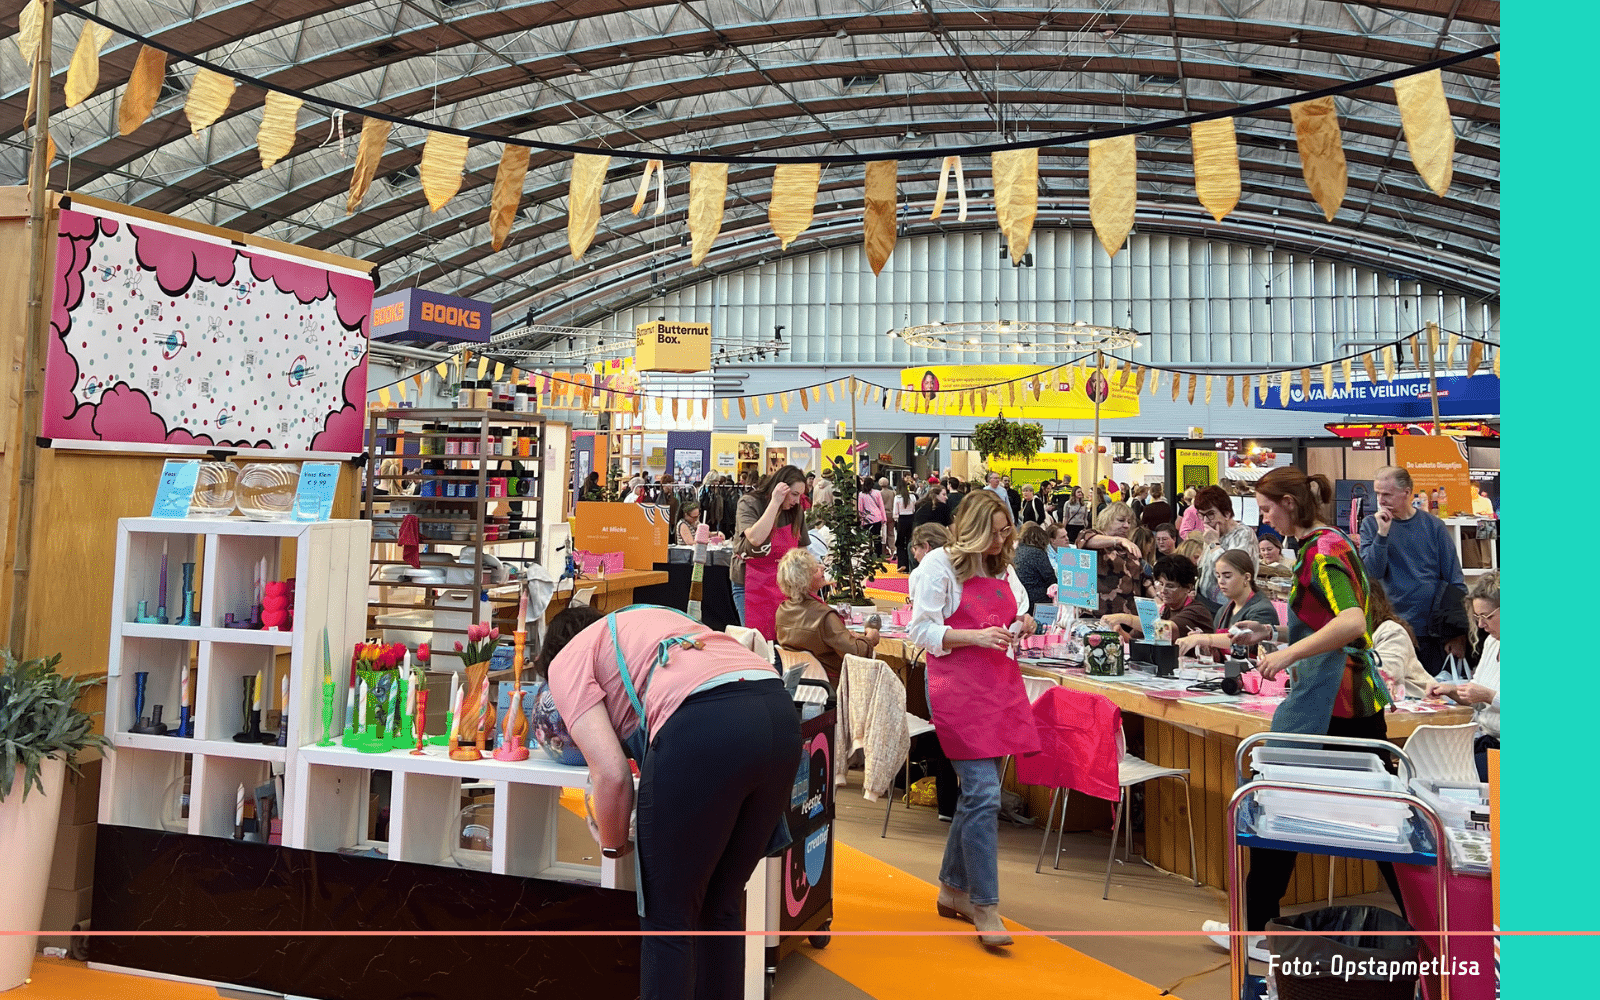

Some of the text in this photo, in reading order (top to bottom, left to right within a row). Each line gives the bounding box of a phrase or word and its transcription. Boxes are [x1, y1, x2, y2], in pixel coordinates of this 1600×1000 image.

[373, 301, 405, 327] BOOKS
[420, 301, 481, 330] BOOKS
[657, 323, 709, 335] Butternut
[657, 333, 681, 344] Box.
